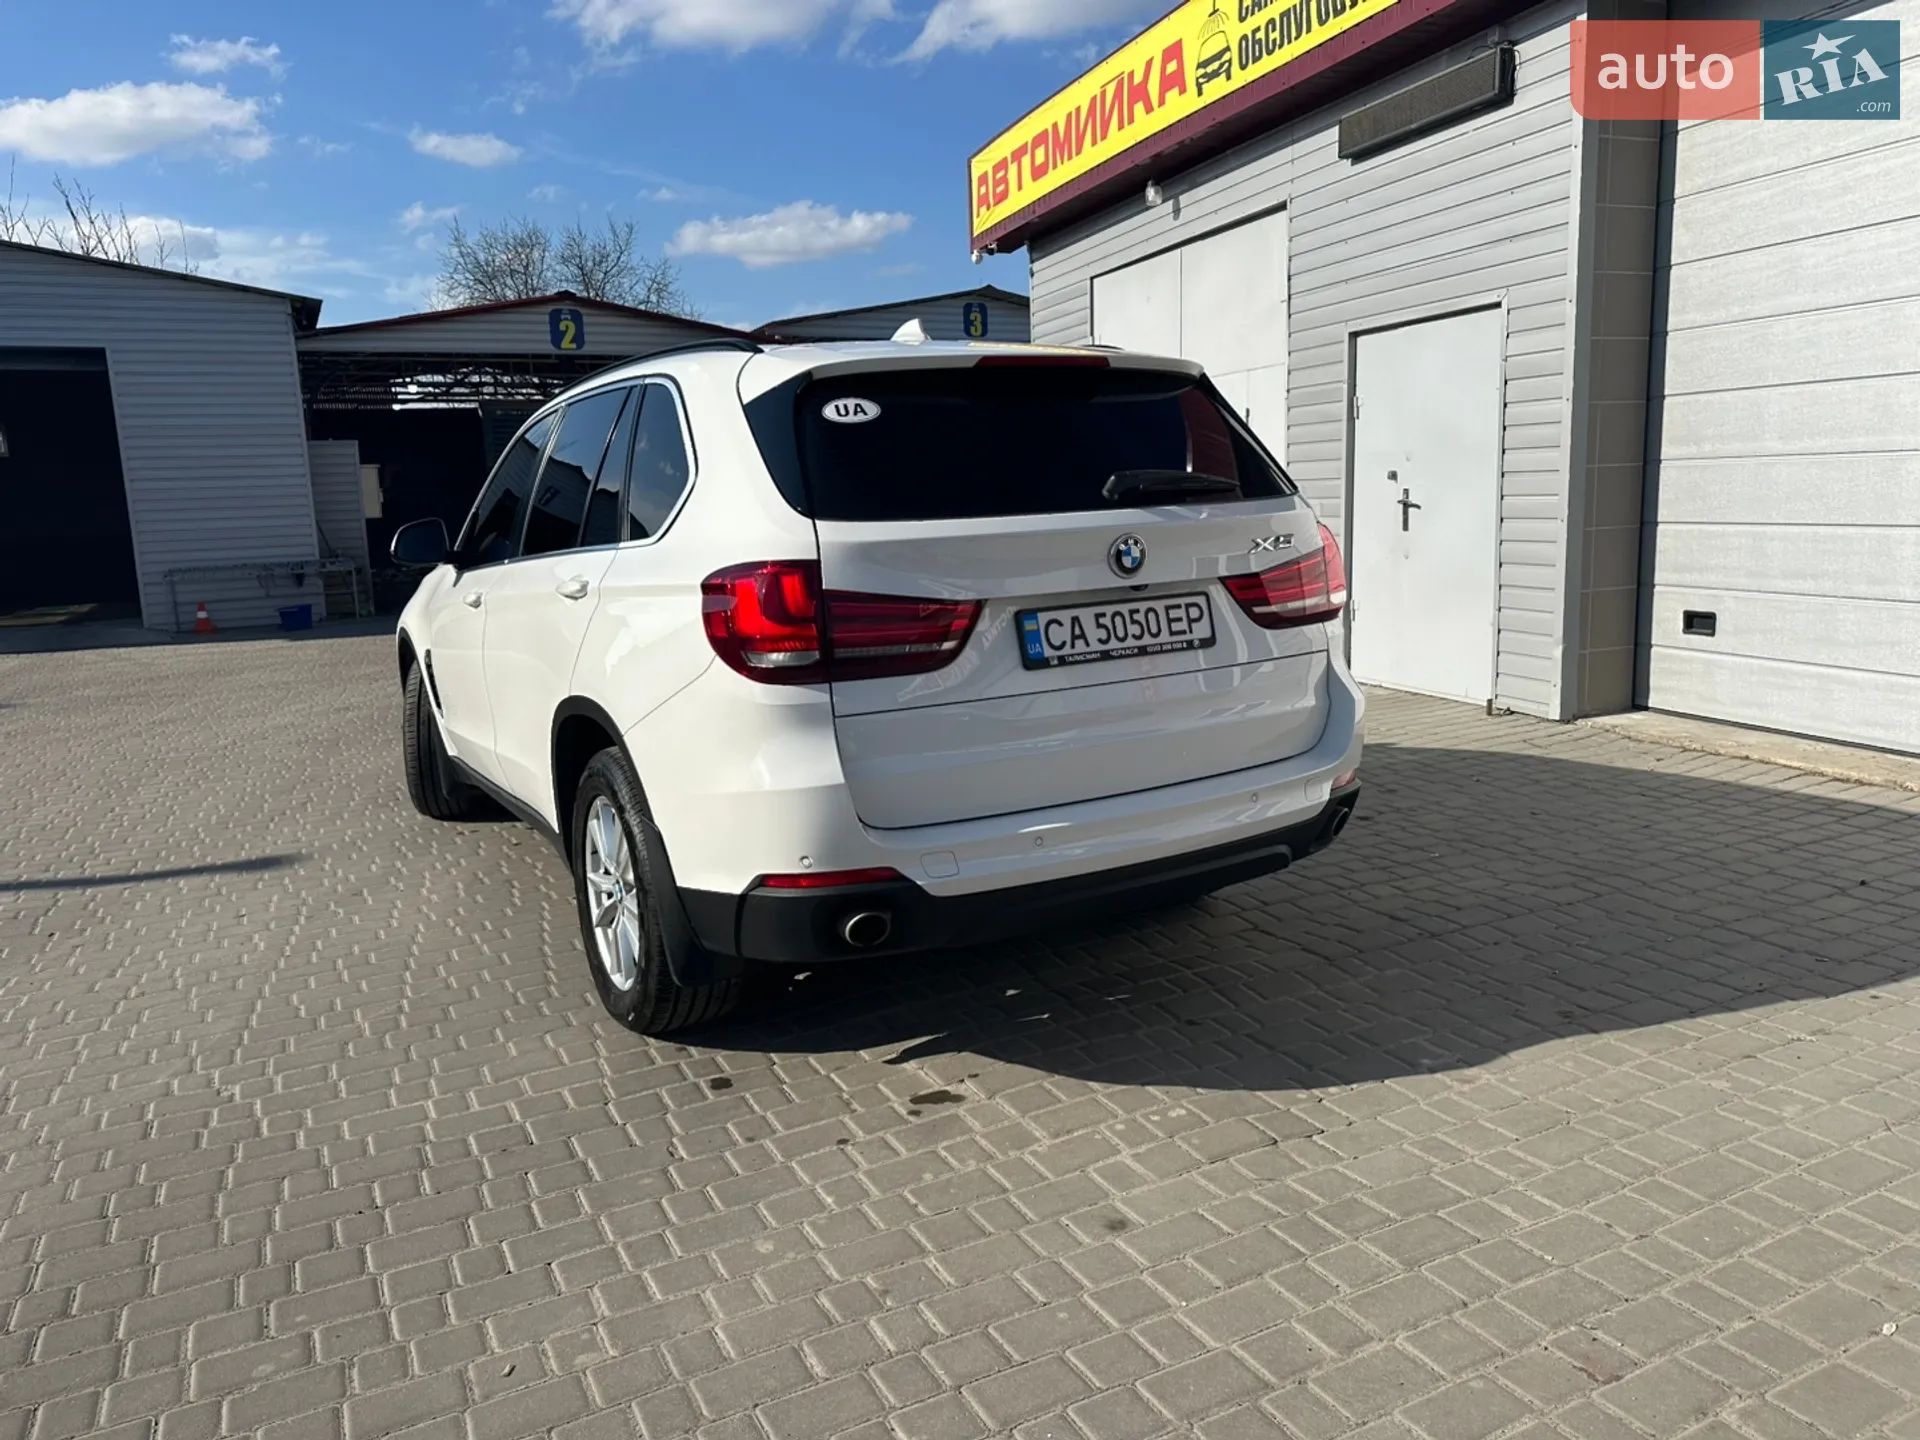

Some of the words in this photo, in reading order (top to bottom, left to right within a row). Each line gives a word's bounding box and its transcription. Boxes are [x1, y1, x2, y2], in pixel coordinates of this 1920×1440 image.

[1238, 0, 1367, 71] ОБСЛУГО
[977, 38, 1187, 219] АВТОМИЙКА
[559, 320, 577, 349] 2
[970, 312, 982, 336] 3
[834, 402, 868, 417] UA
[1044, 615, 1090, 651] CA
[1094, 607, 1162, 646] 5050
[1164, 602, 1204, 637] EP
[1027, 643, 1042, 653] UA
